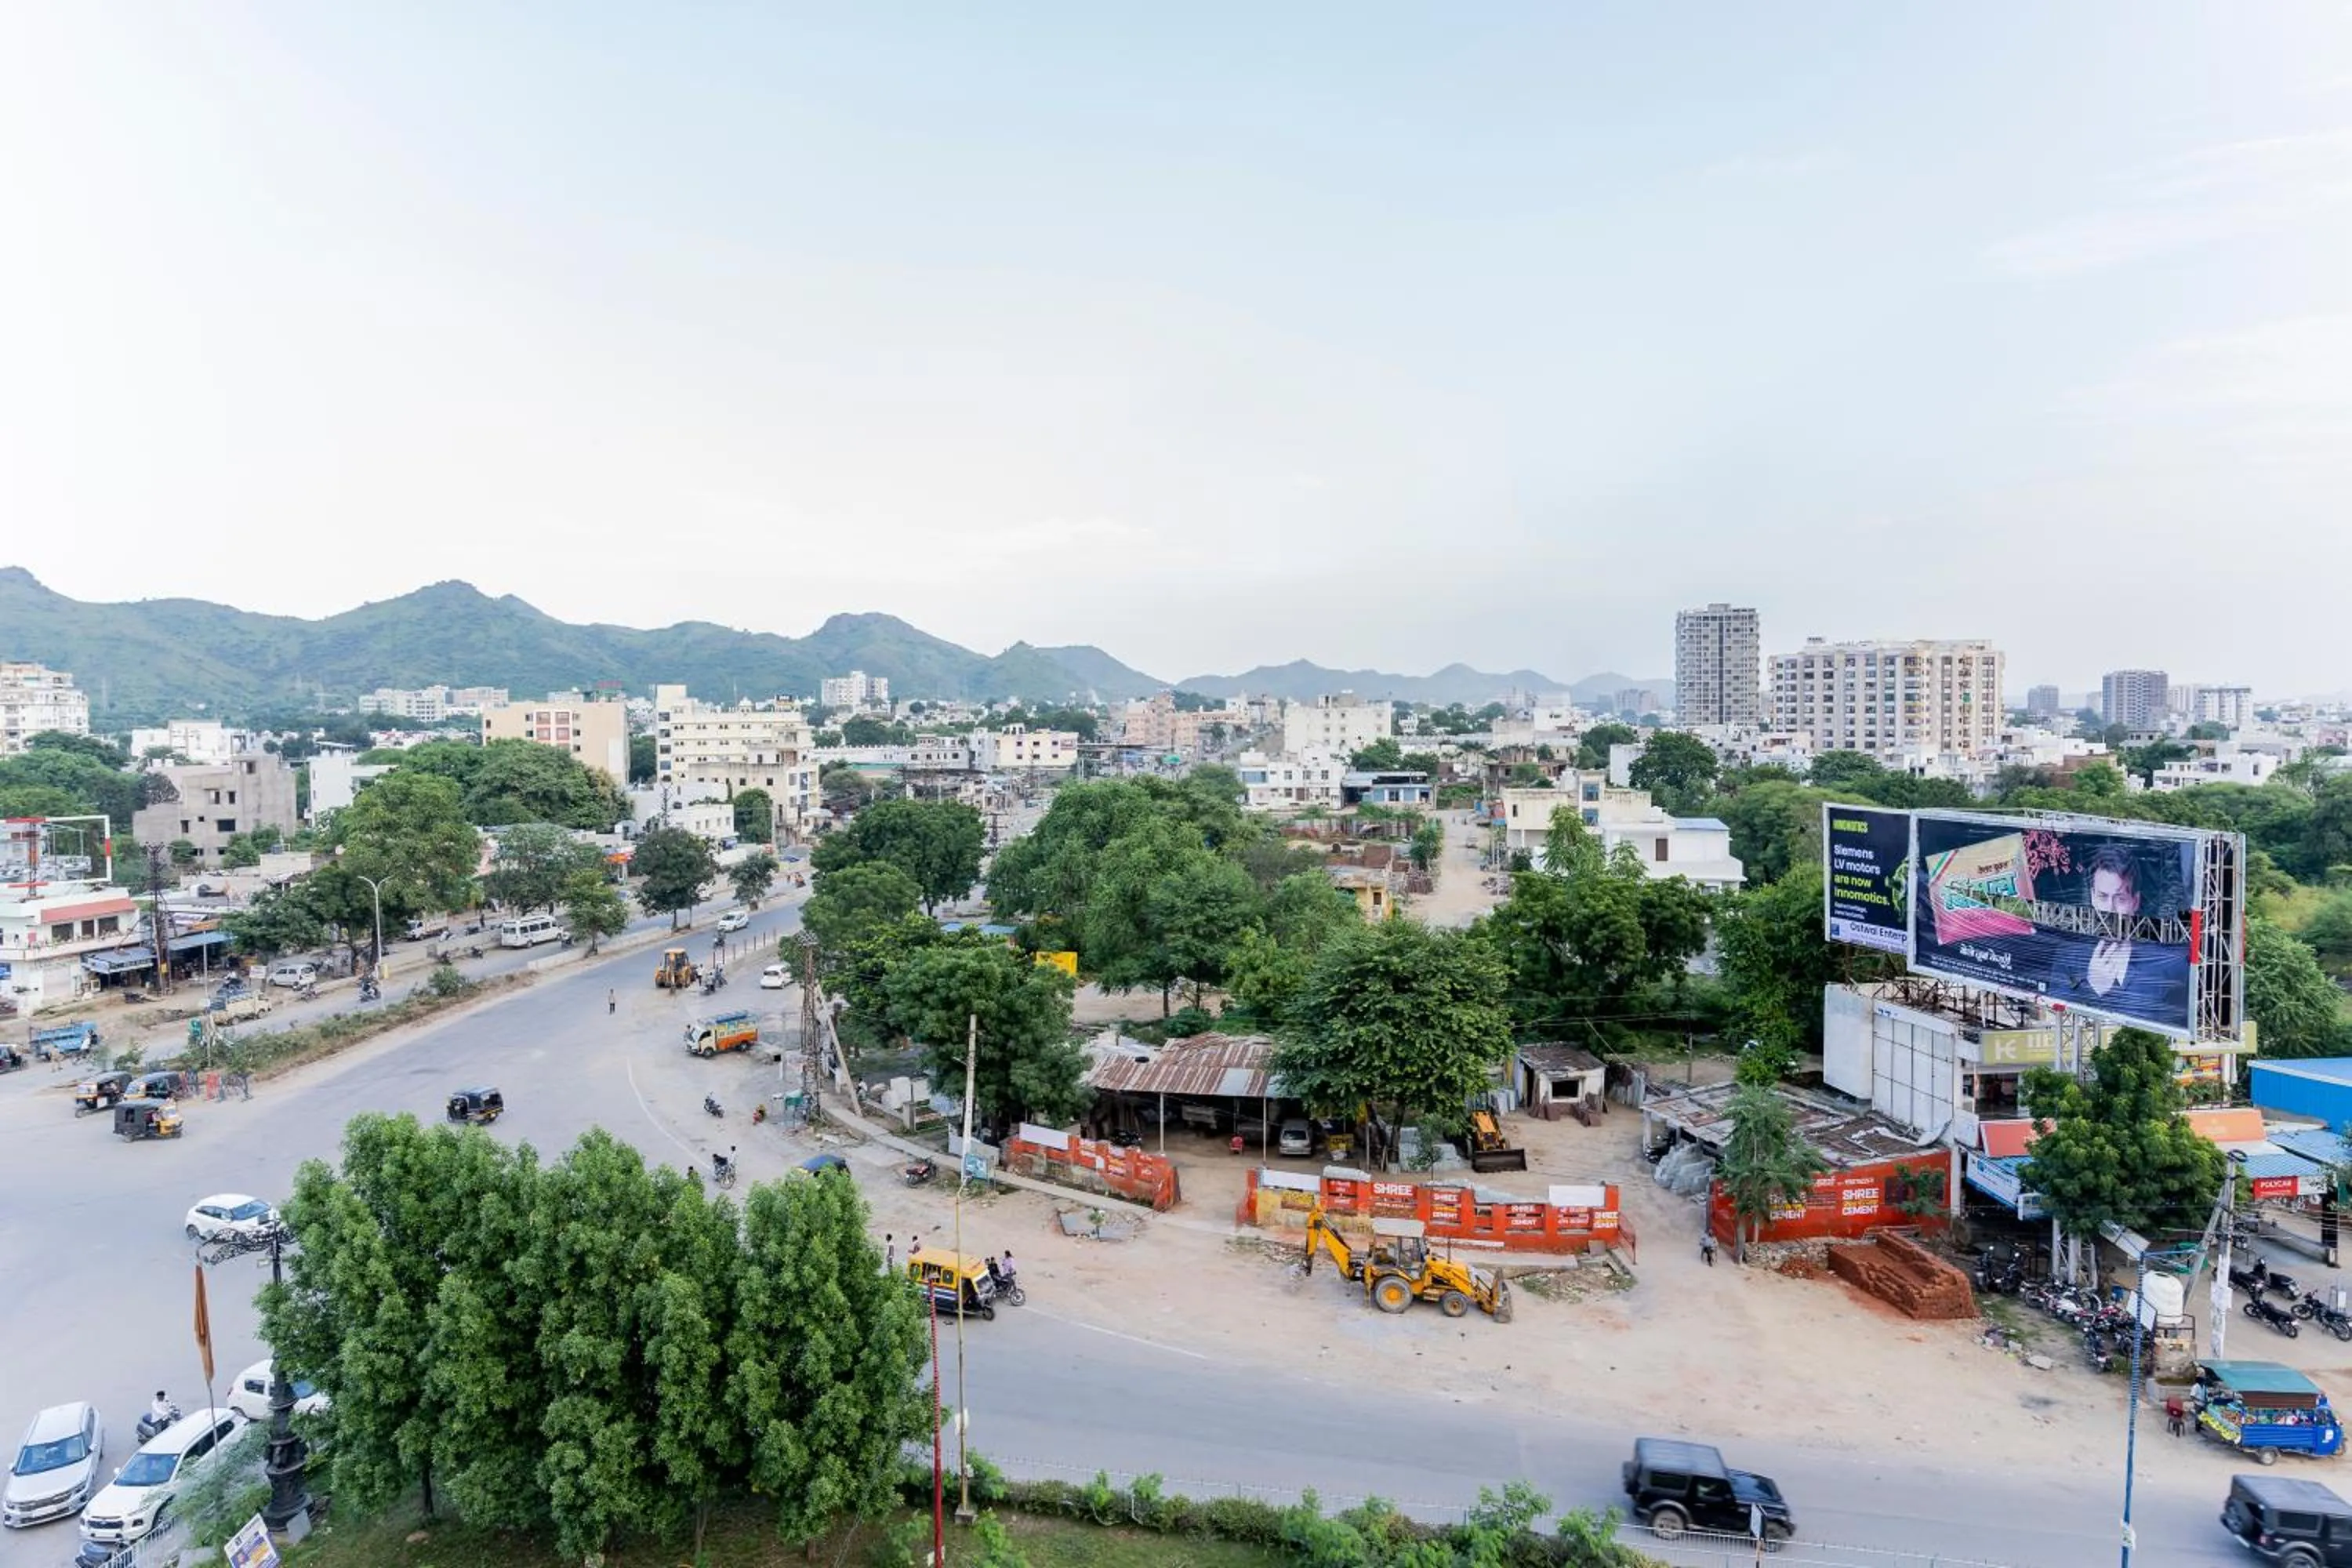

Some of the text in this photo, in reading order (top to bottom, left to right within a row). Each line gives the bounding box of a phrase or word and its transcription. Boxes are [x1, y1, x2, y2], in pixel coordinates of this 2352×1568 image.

[1835, 844, 1874, 860] Siemens
[1835, 858, 1881, 875] LV motors
[1835, 874, 1871, 887] are now
[1374, 1182, 1414, 1196] SHREE
[1842, 1188, 1880, 1200] SHREE
[1433, 1192, 1457, 1202] SHREE
[1511, 1203, 1536, 1213] SHREE
[1842, 1205, 1879, 1216] CEMENT
[1432, 1210, 1458, 1219] CEMENT
[1769, 1209, 1806, 1221] CEMENT
[1511, 1218, 1537, 1226] CEMENT
